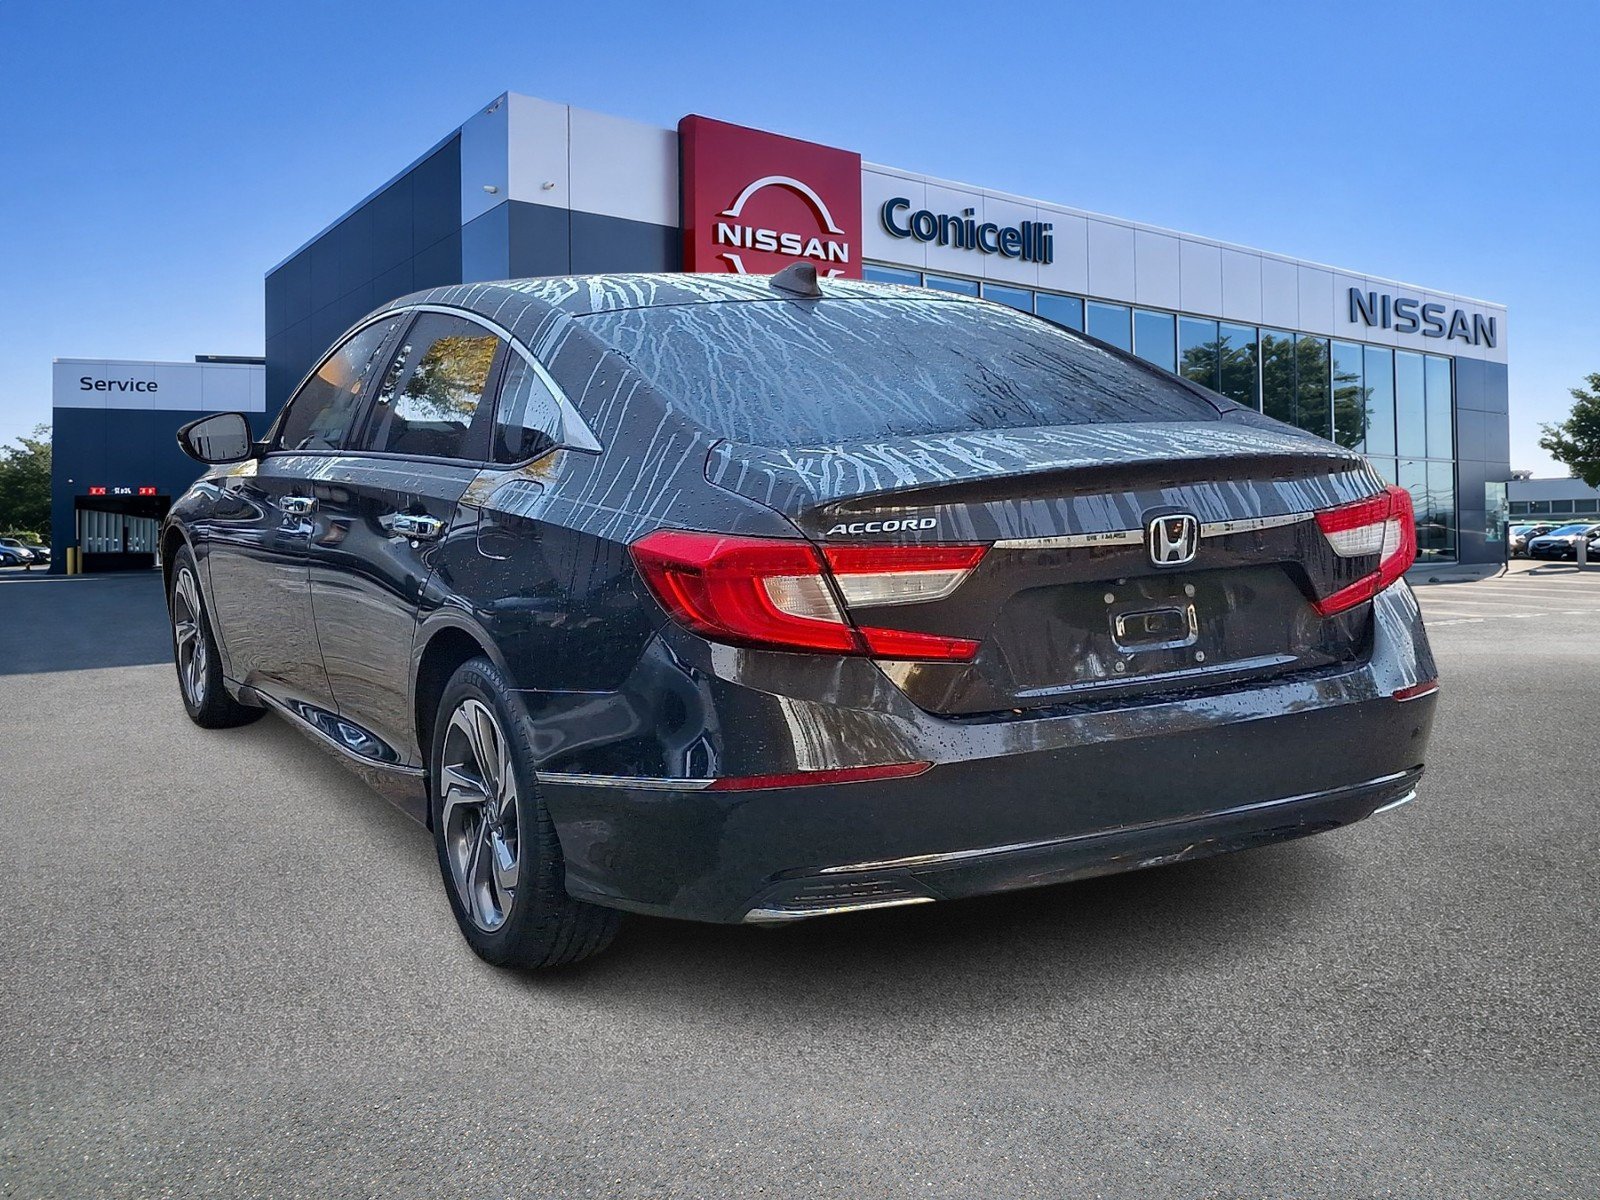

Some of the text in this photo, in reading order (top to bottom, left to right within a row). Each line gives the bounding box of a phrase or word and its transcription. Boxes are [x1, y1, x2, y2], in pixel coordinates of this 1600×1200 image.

[717, 222, 850, 263] NISSAN
[882, 197, 1053, 264] Conicelli
[1349, 287, 1497, 348] NISSAN
[80, 376, 158, 393] Service
[826, 517, 937, 536] ACCORD
